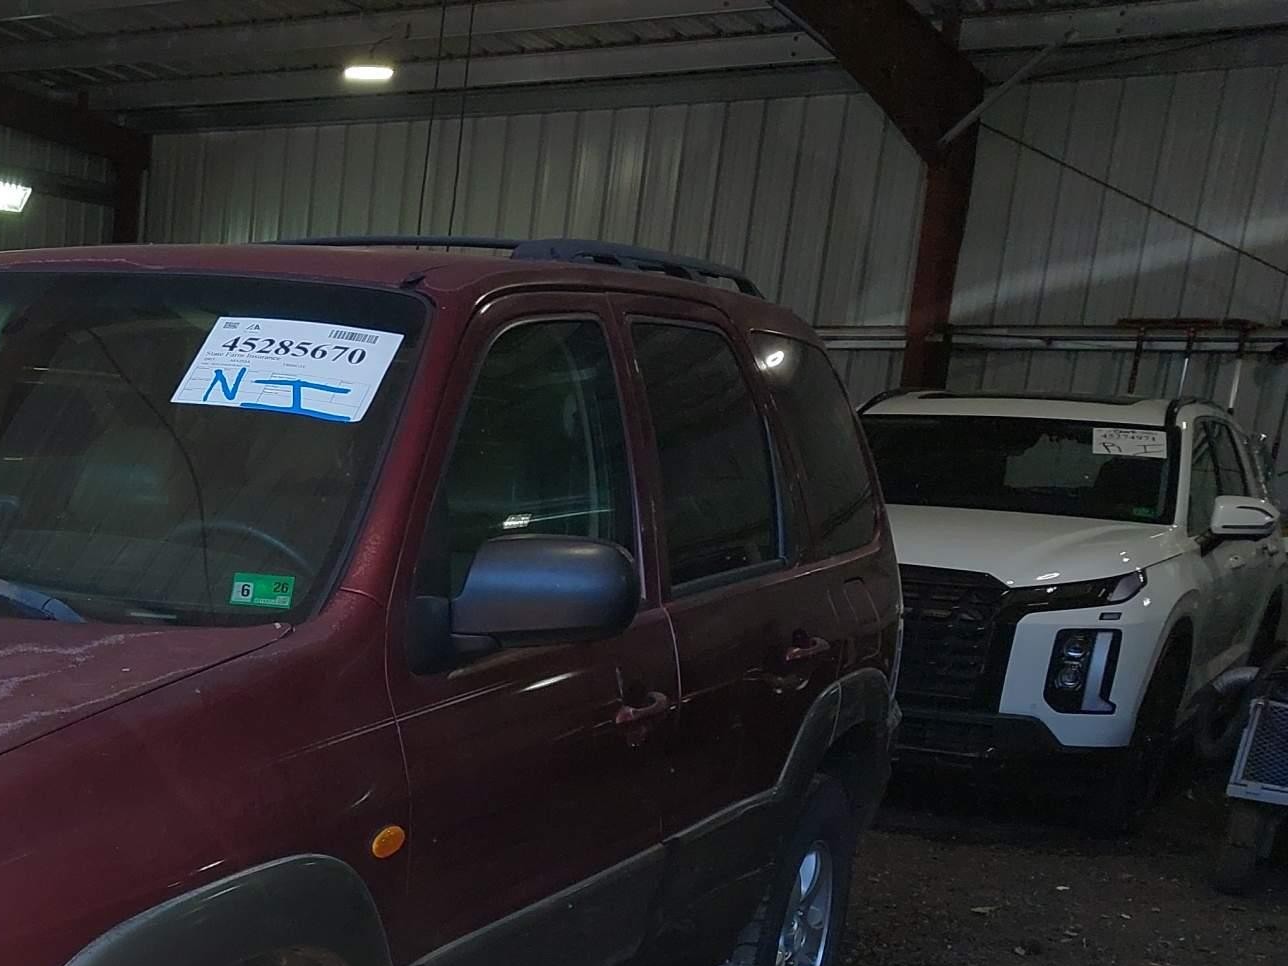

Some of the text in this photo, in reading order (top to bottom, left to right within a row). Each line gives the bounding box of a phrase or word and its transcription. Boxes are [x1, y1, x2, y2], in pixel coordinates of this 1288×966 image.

[221, 336, 367, 365] 45285670
[203, 367, 352, 423] N I
[241, 583, 251, 597] 6
[273, 582, 289, 593] 26
